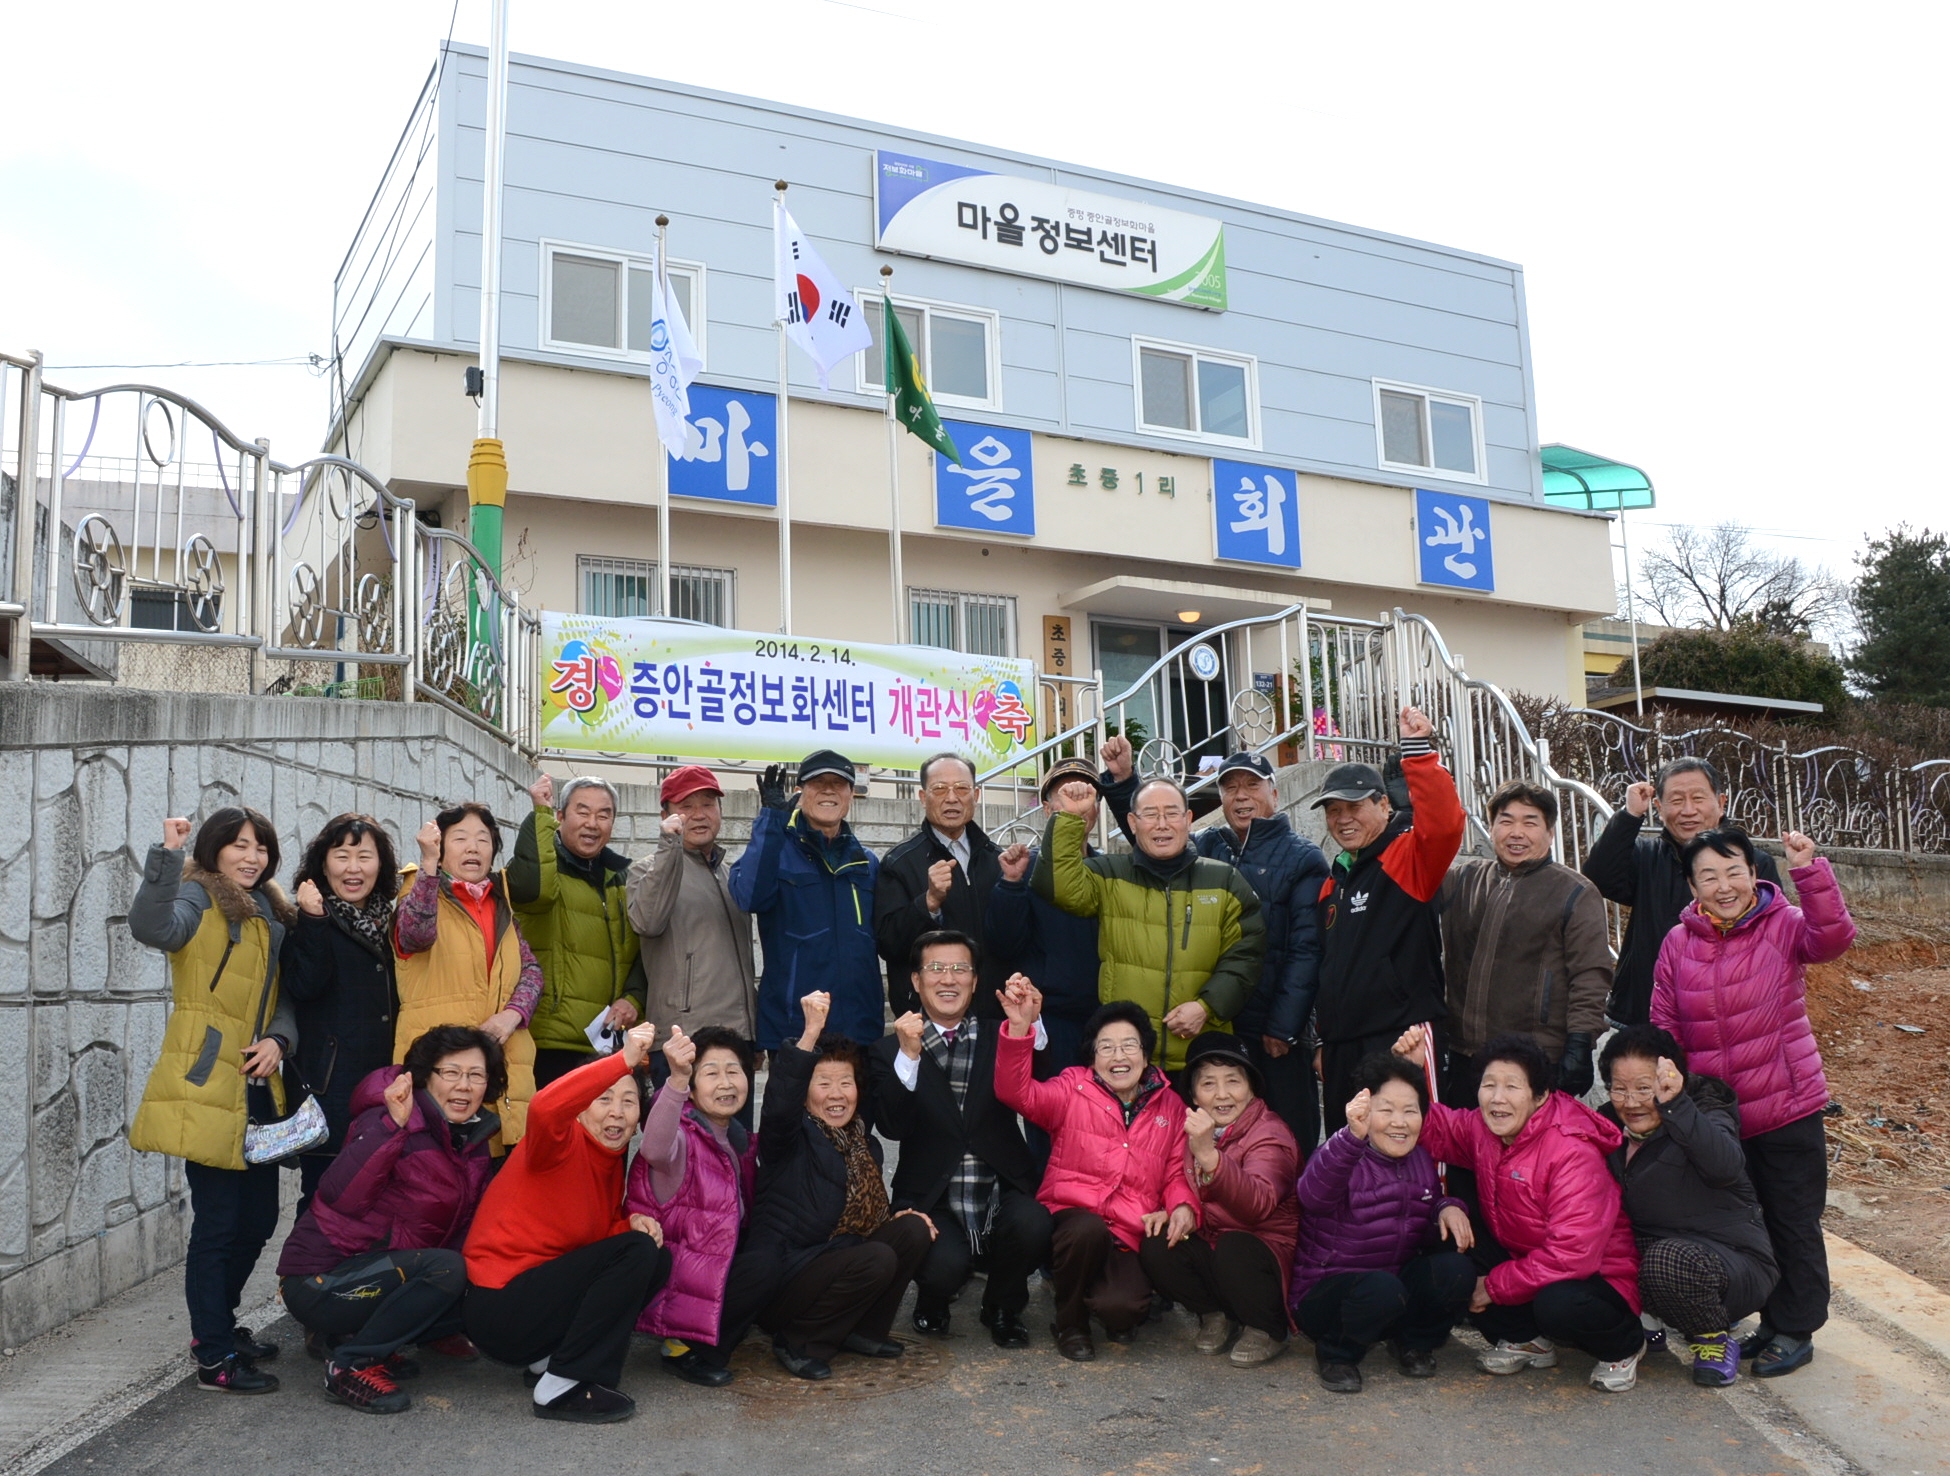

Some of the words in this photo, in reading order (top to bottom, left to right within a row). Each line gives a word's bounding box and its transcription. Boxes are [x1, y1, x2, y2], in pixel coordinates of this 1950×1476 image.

[957, 201, 1158, 273] 마을정보센터
[551, 656, 597, 713] 경
[630, 662, 875, 735] 증안골정보화센터
[888, 681, 969, 741] 개관식
[990, 694, 1032, 742] 축
